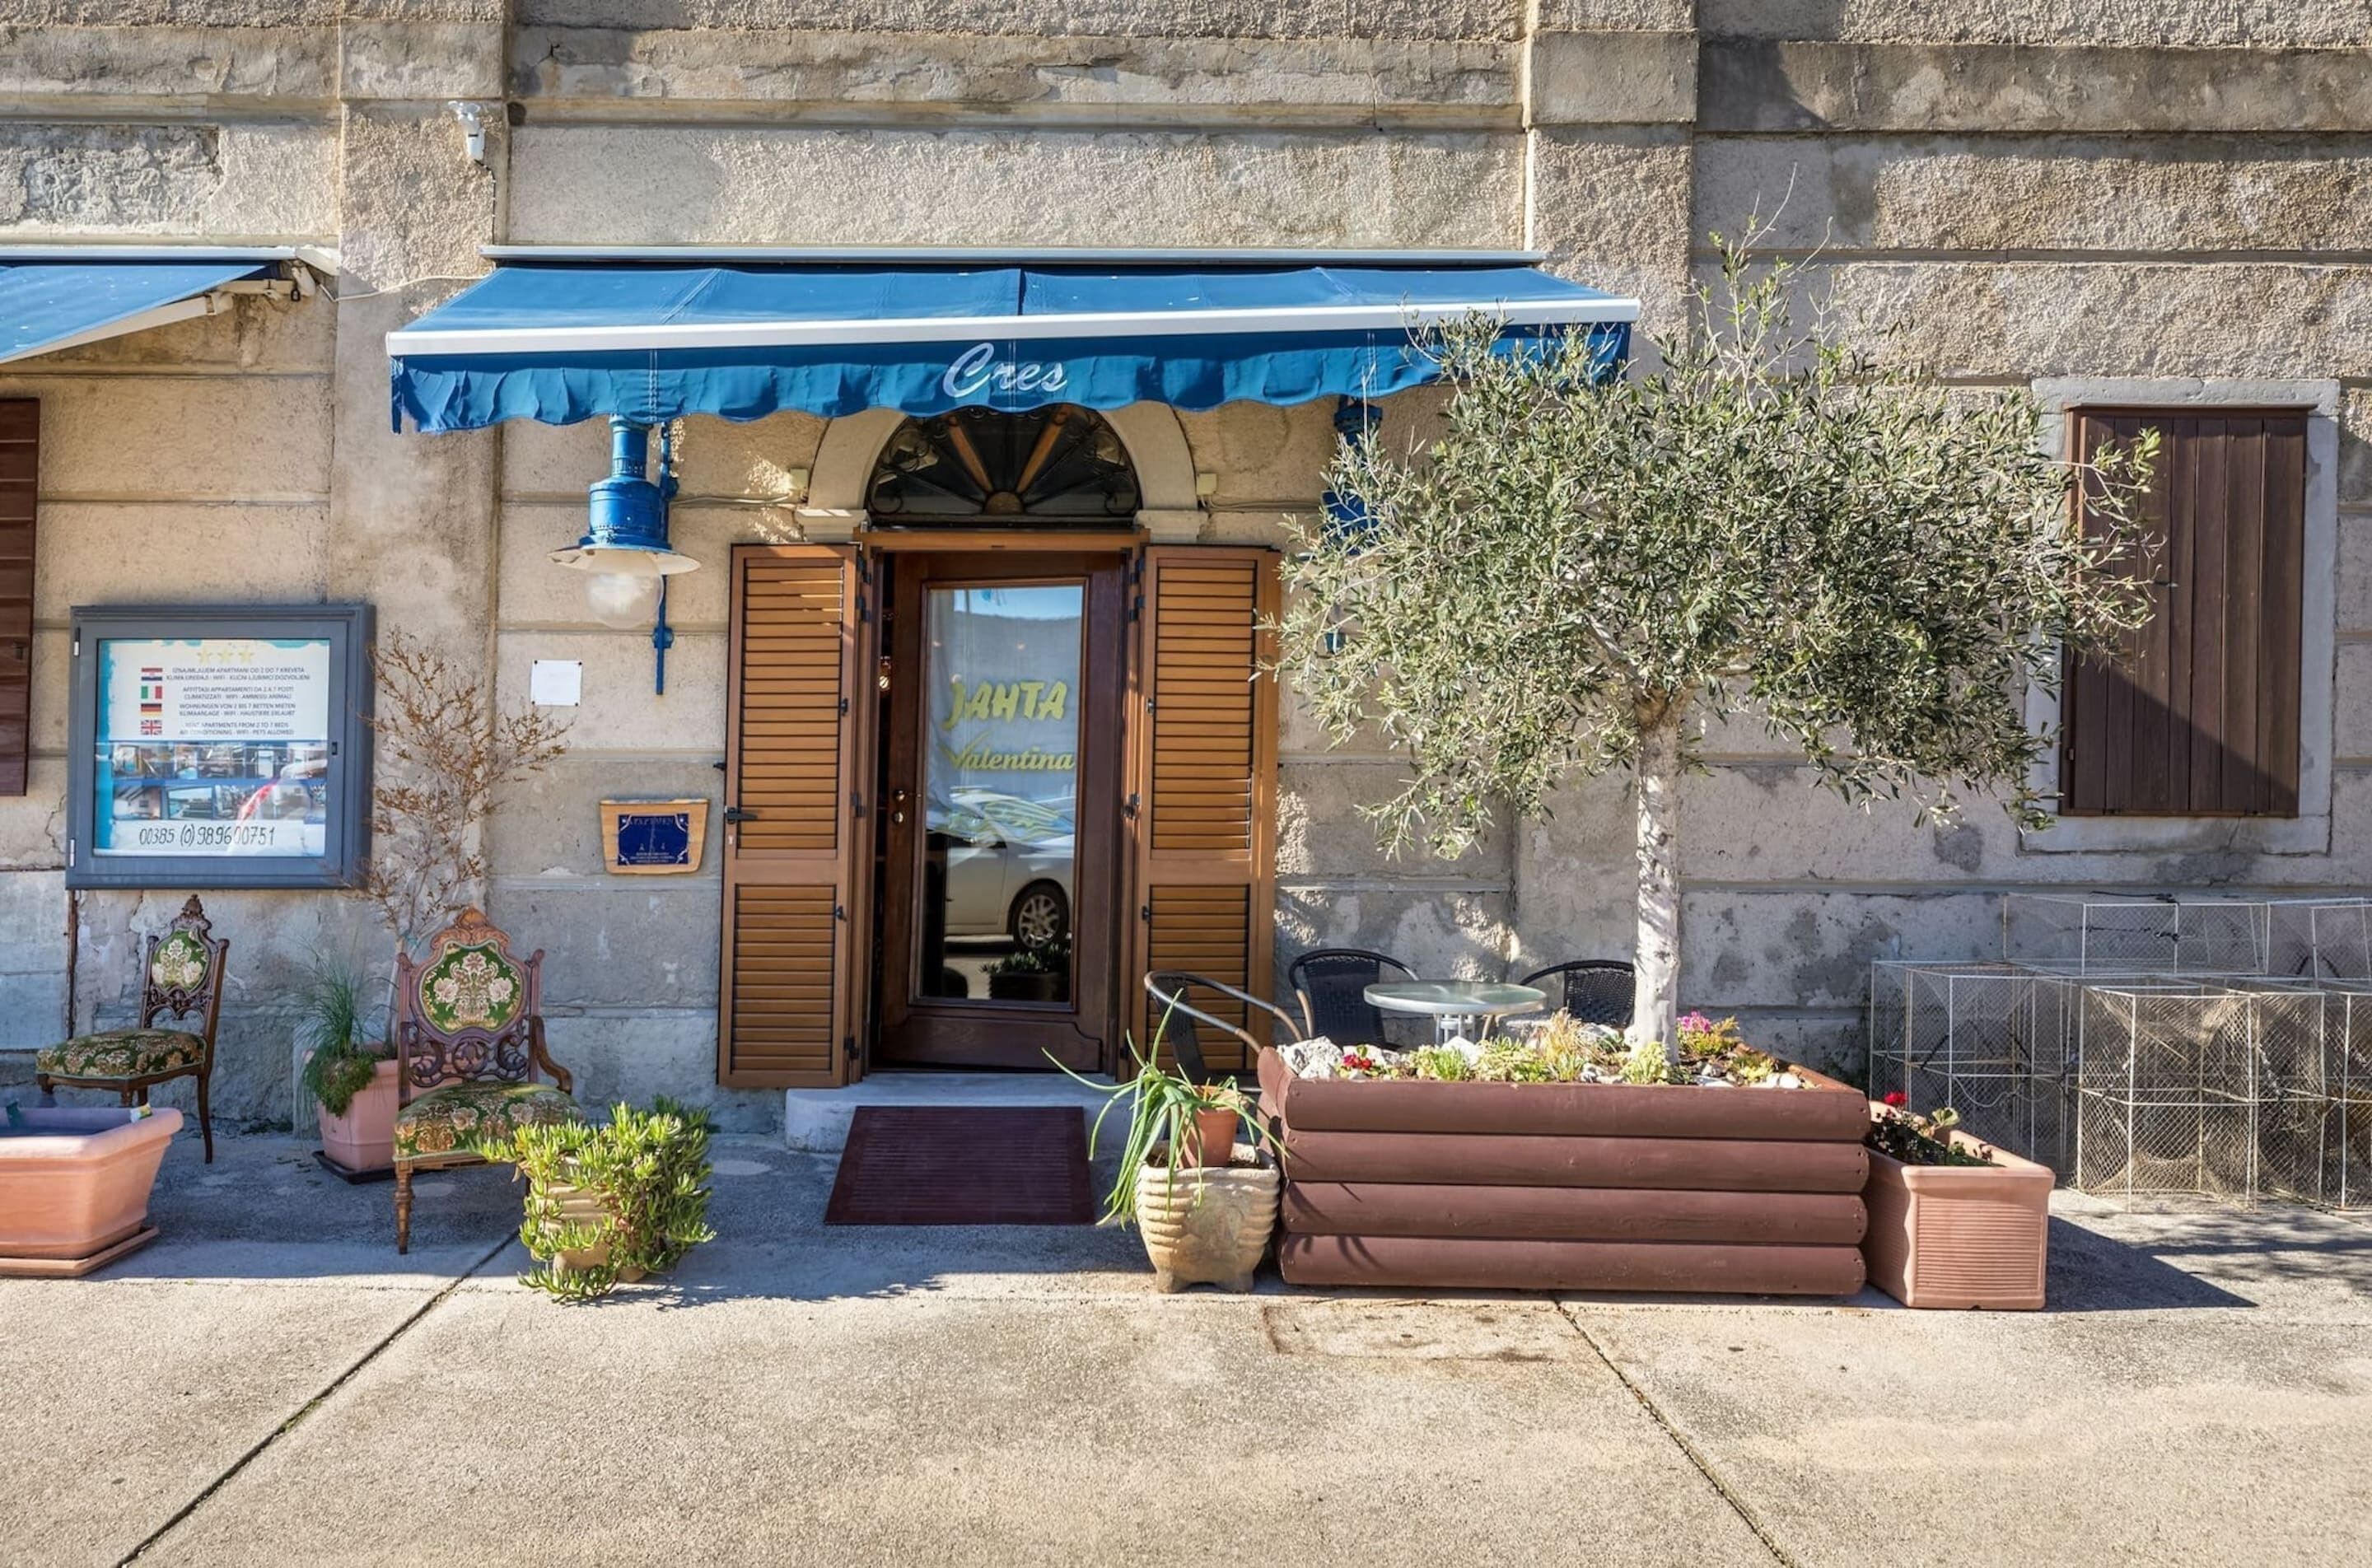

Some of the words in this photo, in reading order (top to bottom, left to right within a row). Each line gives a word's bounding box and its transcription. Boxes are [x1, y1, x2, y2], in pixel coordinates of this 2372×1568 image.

[942, 342, 1068, 399] Cres
[941, 680, 1068, 730] JAHTA
[936, 726, 1076, 771] Valentina
[138, 828, 175, 845] 00385
